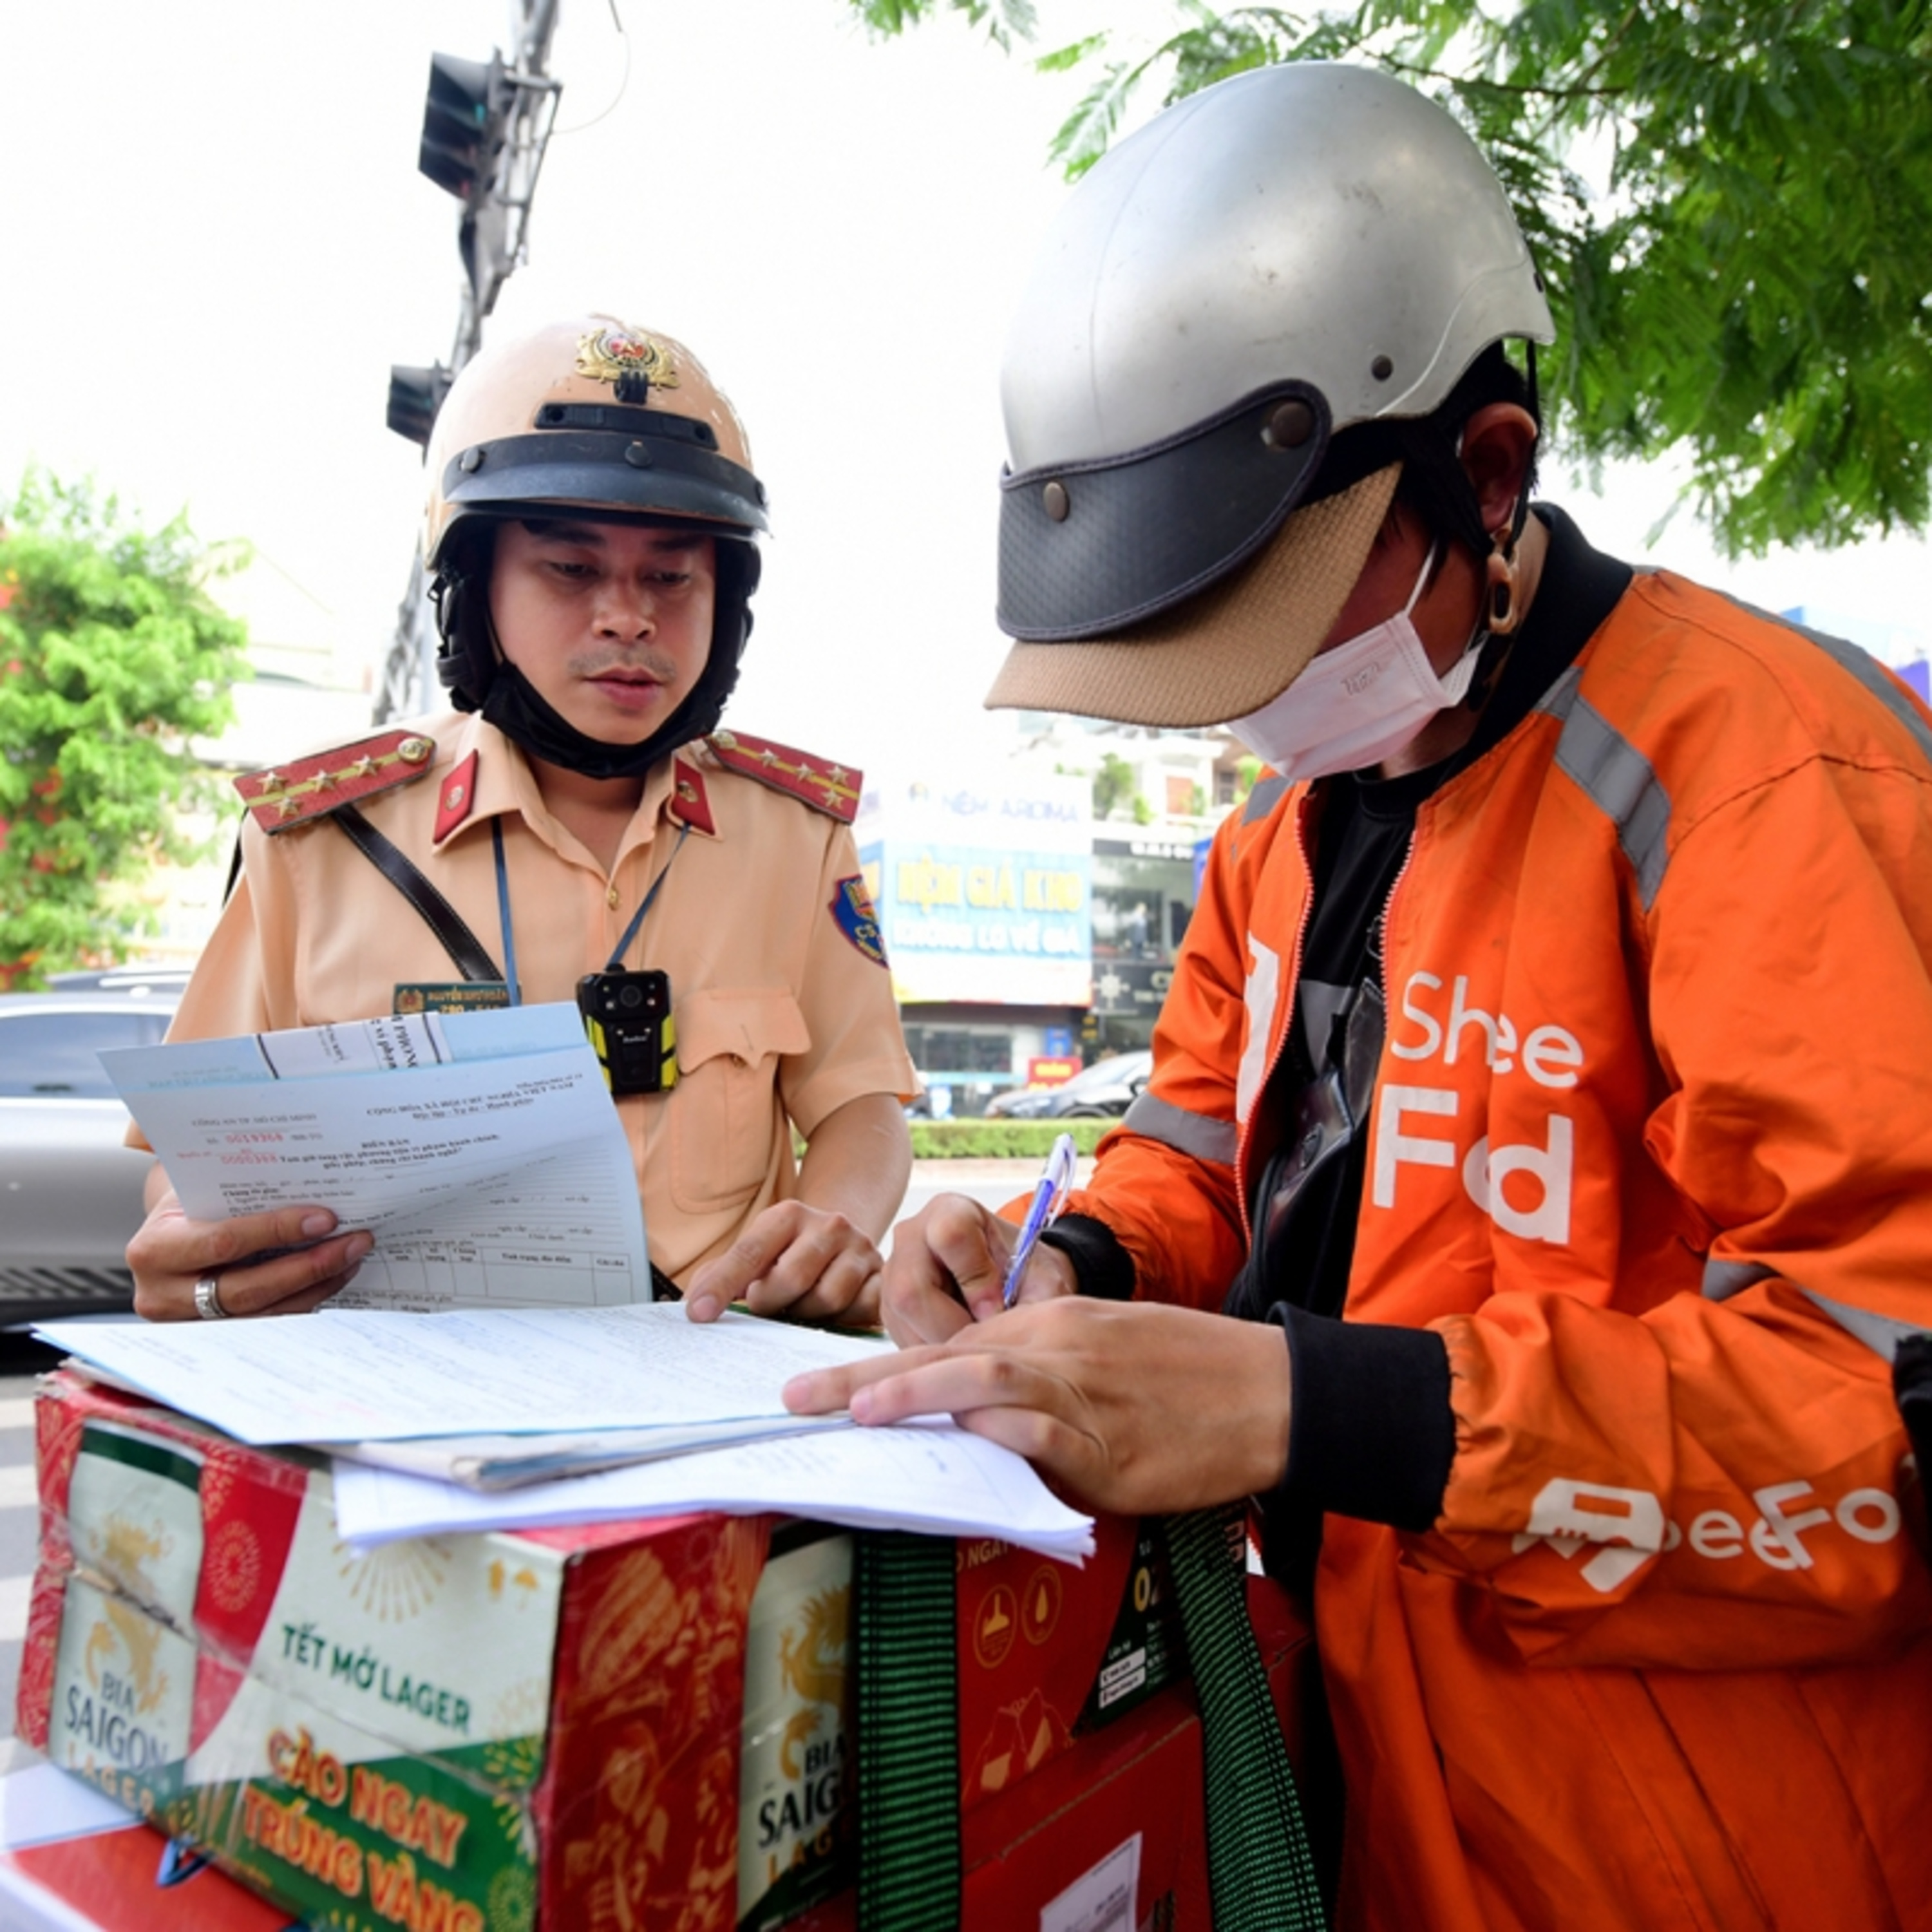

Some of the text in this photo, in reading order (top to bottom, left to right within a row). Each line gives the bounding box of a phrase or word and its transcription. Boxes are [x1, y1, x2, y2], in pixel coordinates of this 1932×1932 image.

[101, 1671, 135, 1716] BIA
[281, 1622, 326, 1671] TẾT
[380, 1667, 470, 1734] LAGER
[65, 1684, 169, 1780] SAIGON
[806, 1734, 848, 1775] BIA
[243, 1778, 363, 1897] TRÚNG
[267, 1724, 469, 1869] CÀO NGAY
